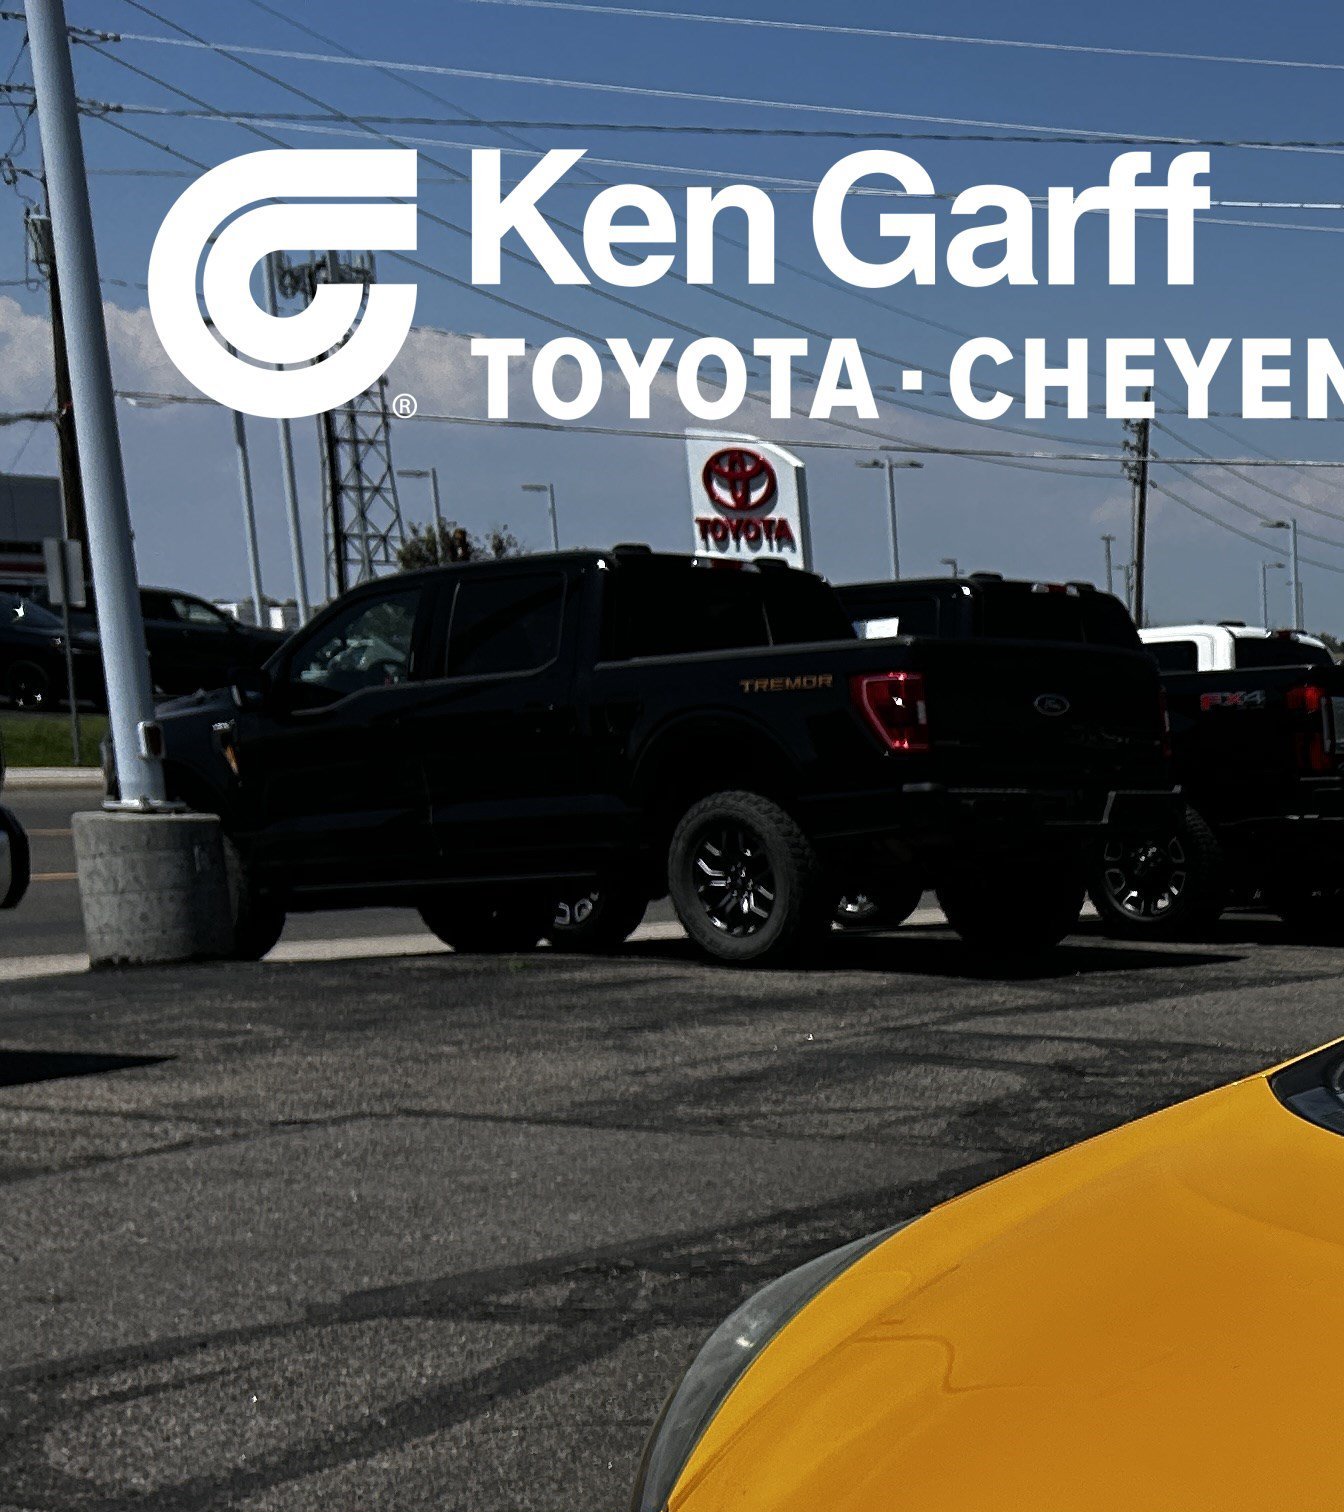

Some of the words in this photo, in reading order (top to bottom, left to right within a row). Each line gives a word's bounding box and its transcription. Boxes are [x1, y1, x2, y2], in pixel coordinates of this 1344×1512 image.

[695, 517, 795, 546] TOYOTA
[738, 673, 833, 694] TREMOR
[1199, 689, 1267, 711] FX4
